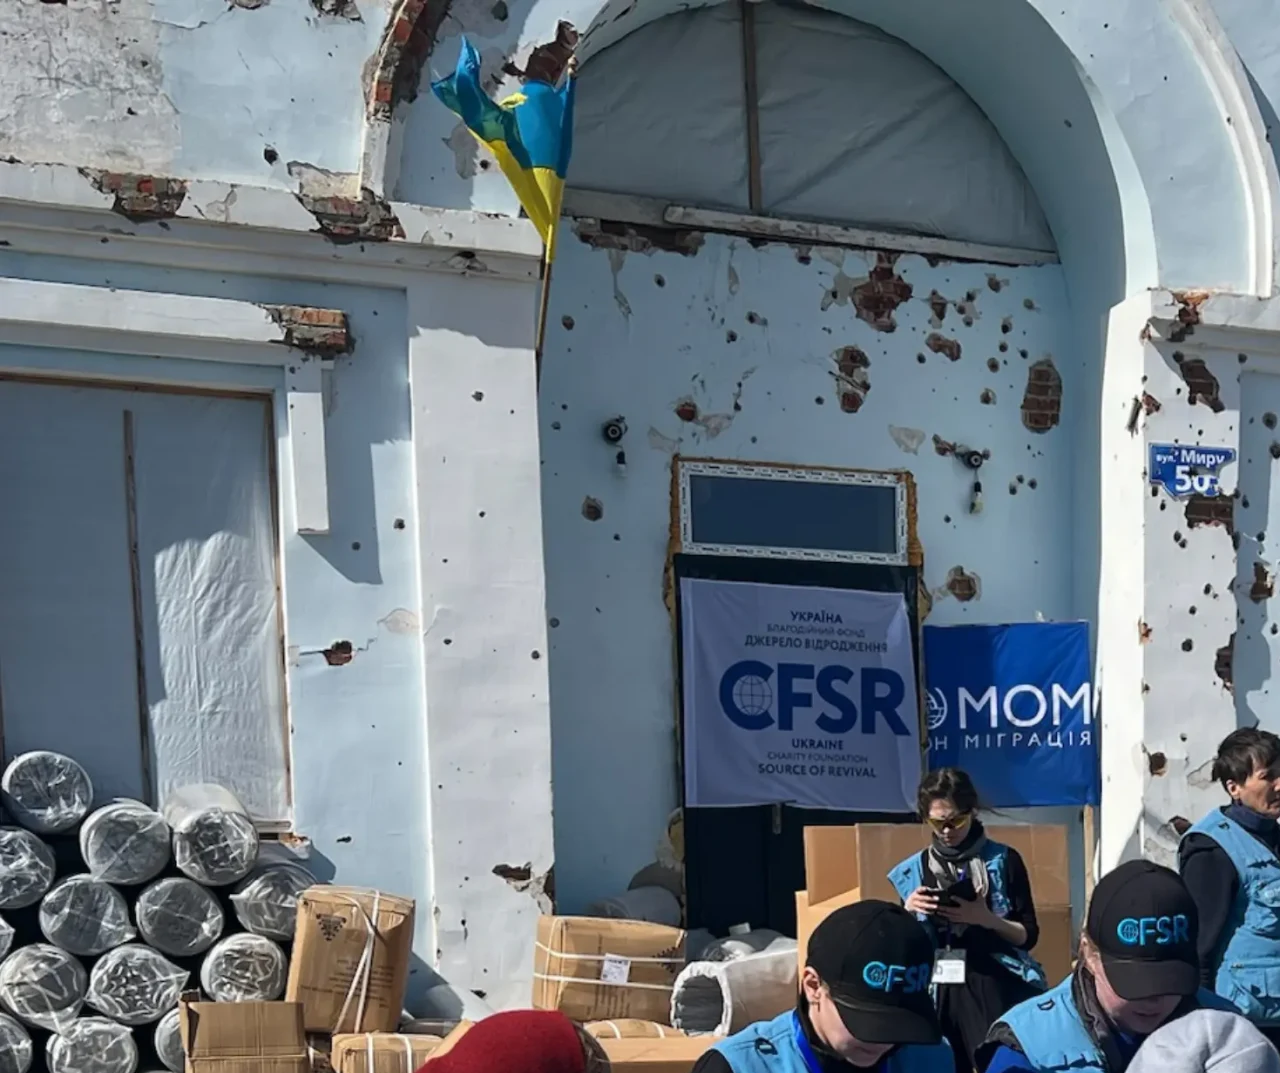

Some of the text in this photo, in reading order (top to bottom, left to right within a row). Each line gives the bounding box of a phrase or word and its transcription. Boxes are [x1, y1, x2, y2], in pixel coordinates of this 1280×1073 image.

[790, 609, 843, 624] УКРАЇНА
[744, 634, 888, 653] ДЖЕРЕЛО ВІДРОДЖЕННЯ
[719, 659, 912, 737] CFSR
[957, 681, 1092, 730] МОМ
[791, 738, 844, 751] UKRAINE
[964, 730, 1092, 749] МІГРАЦІЯ
[808, 752, 869, 764] FOUNDATION
[758, 763, 877, 778] SOURCE OF REVIVAL
[1117, 914, 1189, 946] CFSR
[862, 961, 930, 993] CFSR
